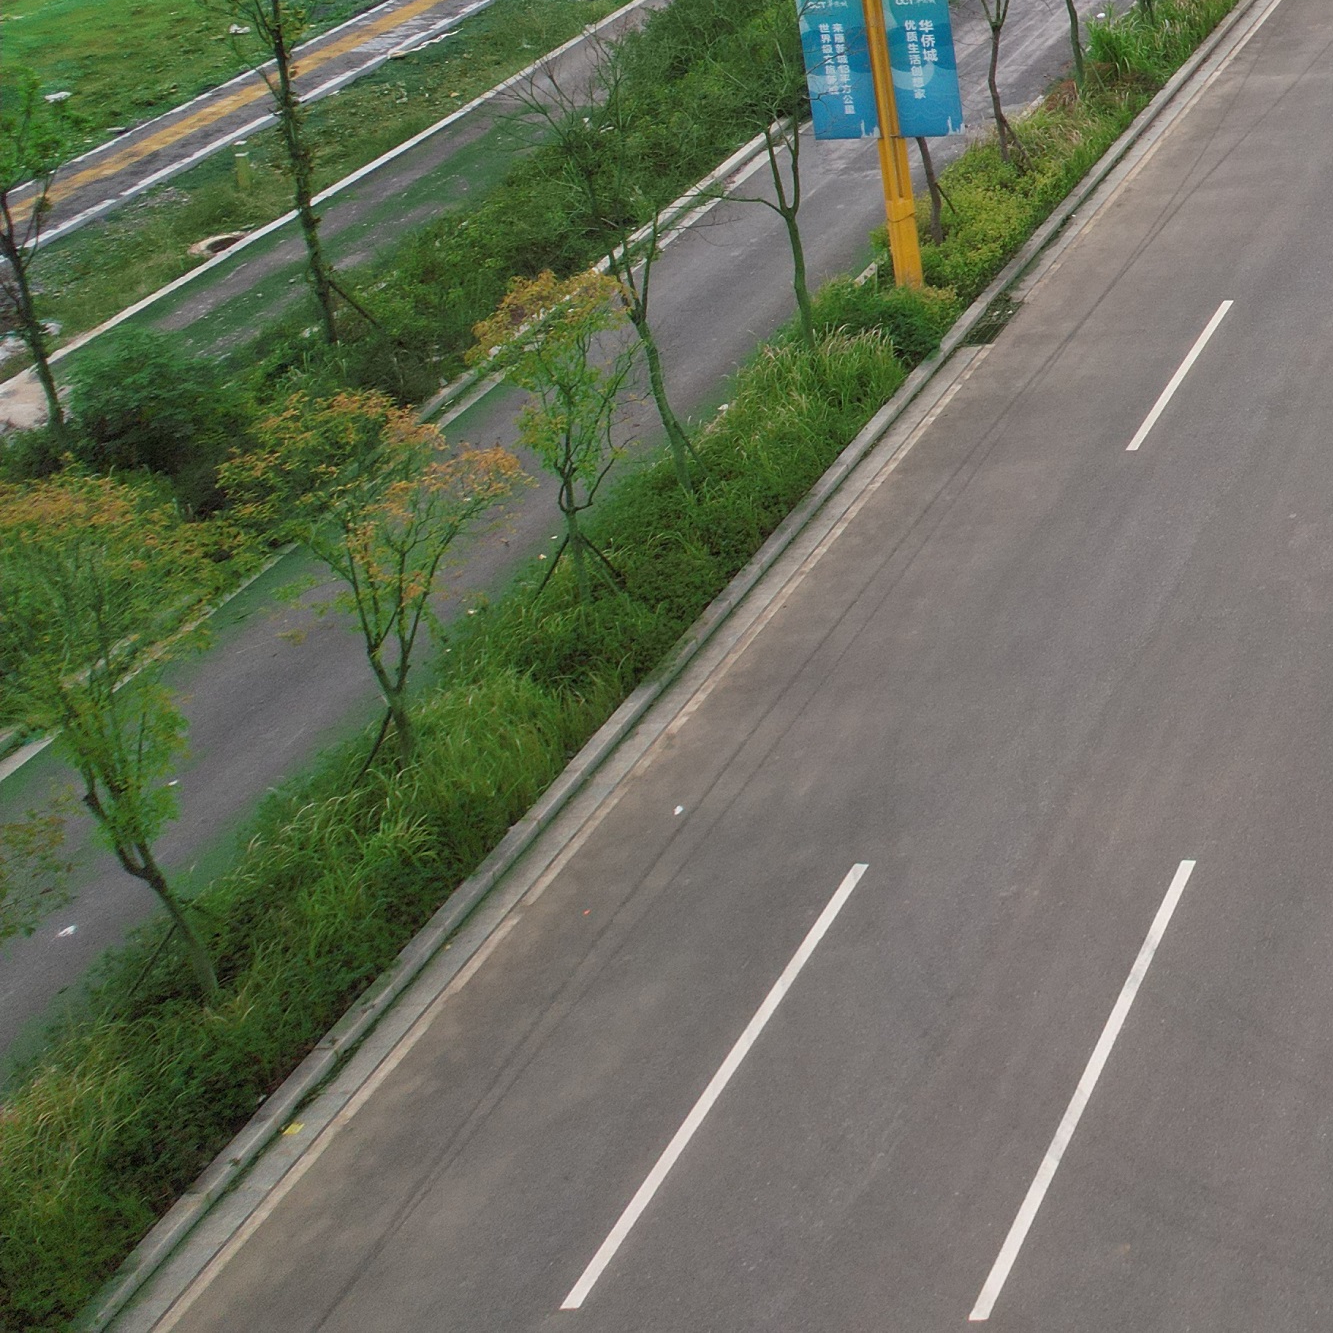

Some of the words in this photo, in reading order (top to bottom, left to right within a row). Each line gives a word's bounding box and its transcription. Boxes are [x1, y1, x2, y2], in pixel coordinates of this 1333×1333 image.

[904, 19, 927, 100] 优质生活创想家
[918, 19, 939, 62] 华侨城
